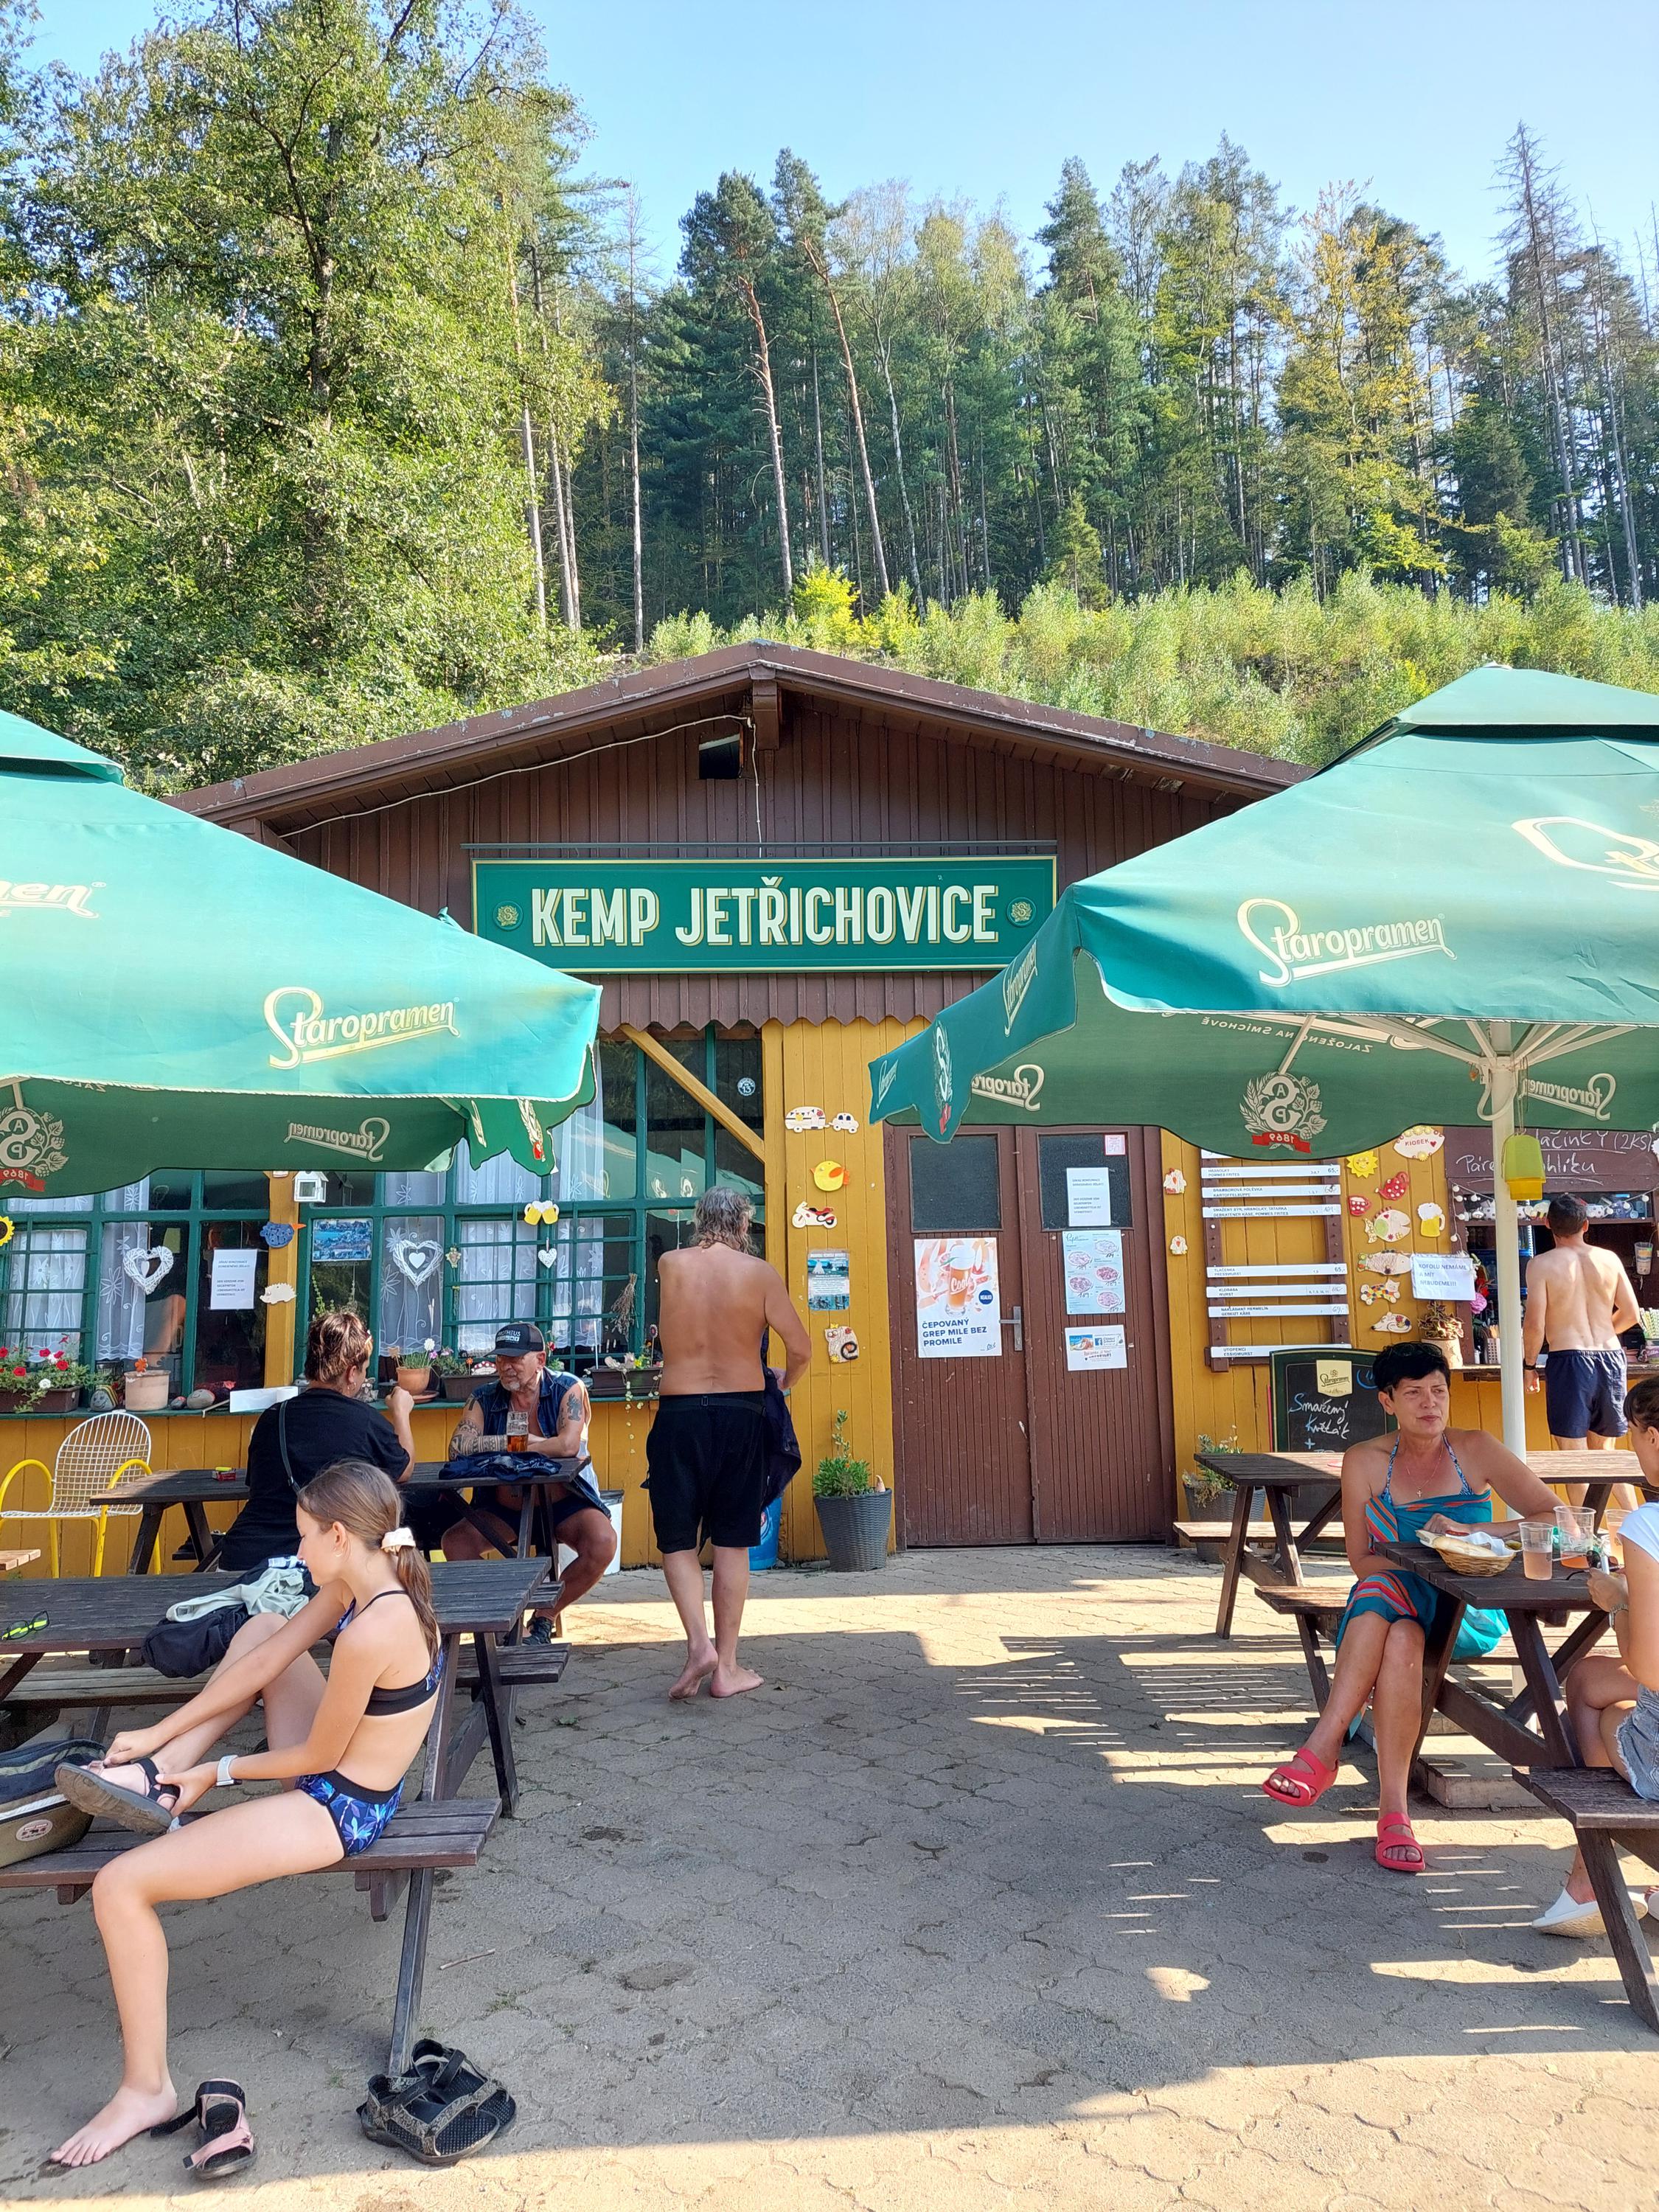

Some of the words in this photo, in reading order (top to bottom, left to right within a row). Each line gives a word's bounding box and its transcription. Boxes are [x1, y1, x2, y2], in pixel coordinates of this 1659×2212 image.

[531, 888, 659, 947] KEMP
[675, 876, 999, 945] JETŘICHOVICE
[1237, 897, 1457, 988] Staropramen
[263, 986, 461, 1070] Staropramen
[922, 1318, 970, 1329] ČEPOVANÝ
[922, 1329, 946, 1338] GREP
[948, 1328, 968, 1336] MILE
[970, 1326, 988, 1335] BEZ
[923, 1337, 963, 1347] PROMILE
